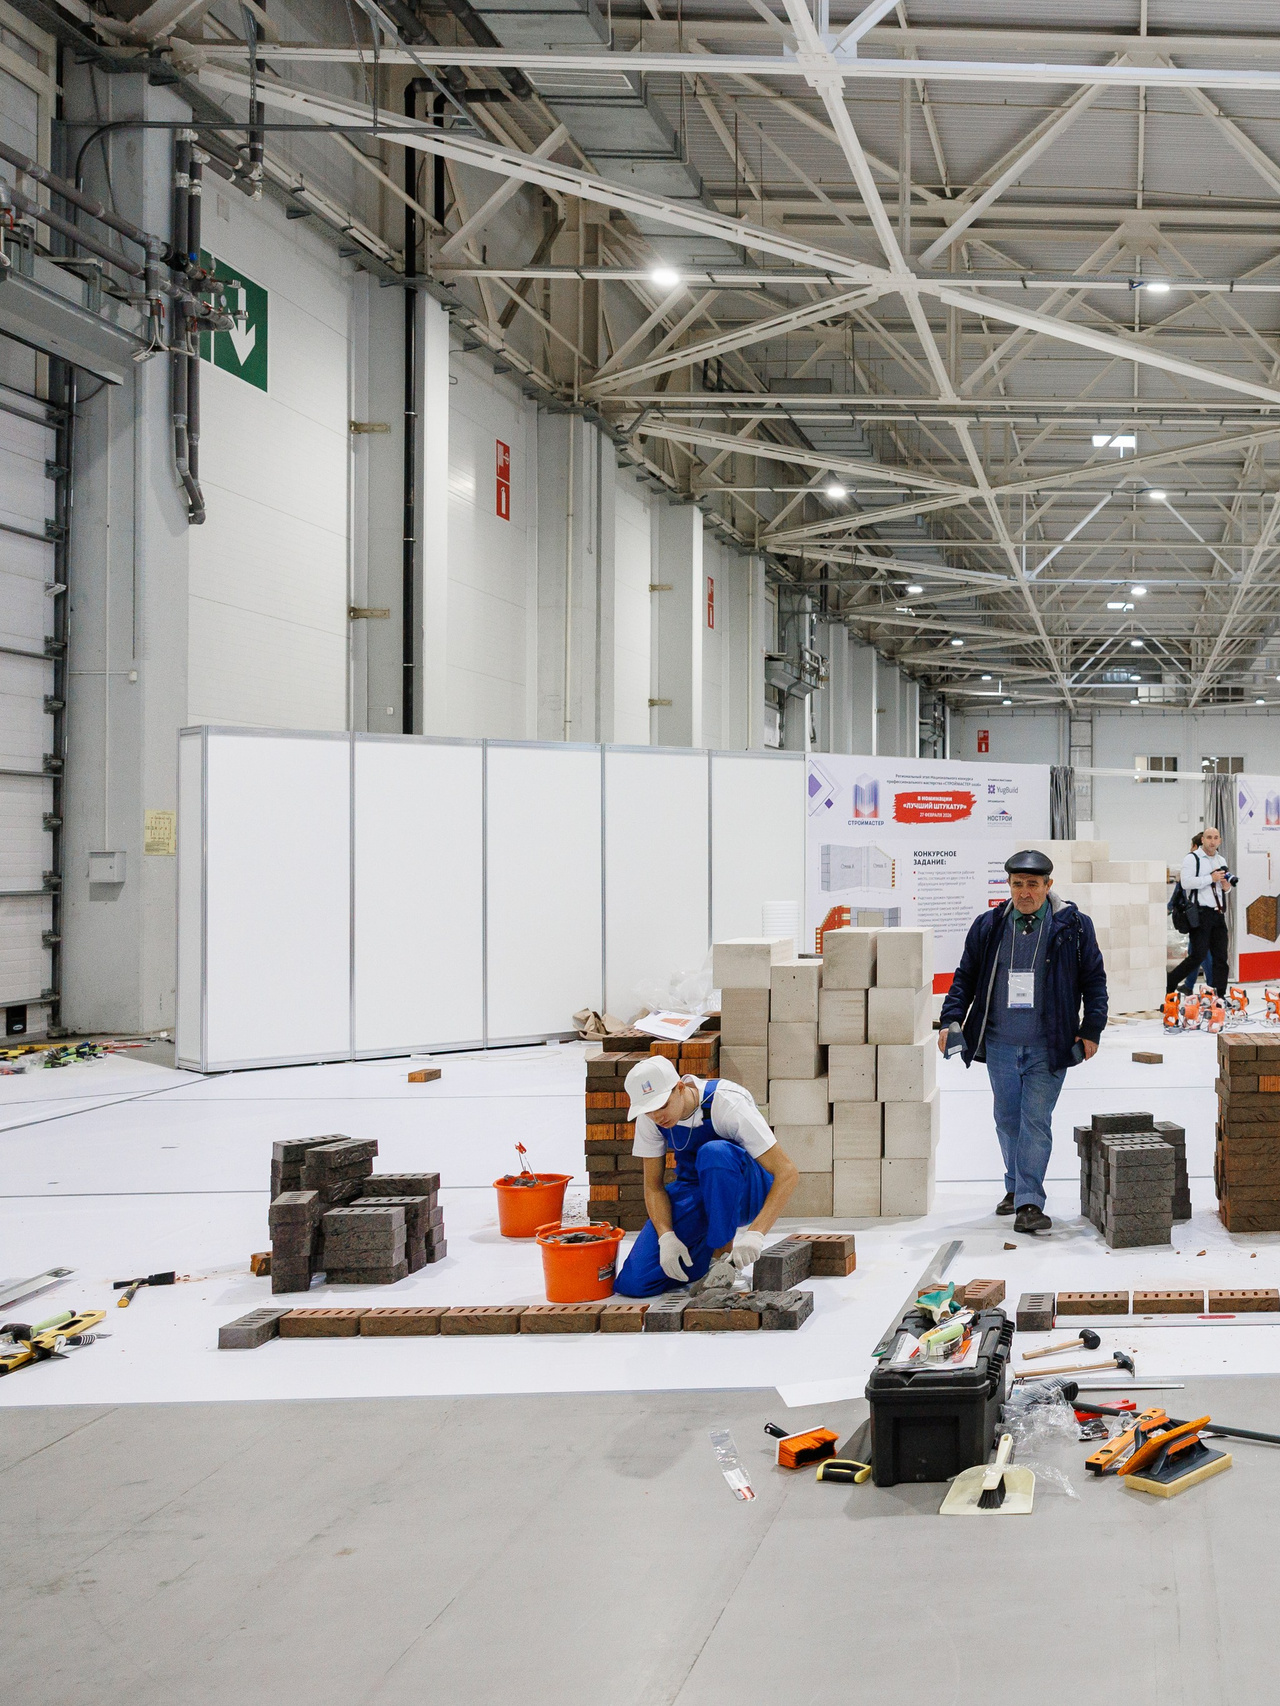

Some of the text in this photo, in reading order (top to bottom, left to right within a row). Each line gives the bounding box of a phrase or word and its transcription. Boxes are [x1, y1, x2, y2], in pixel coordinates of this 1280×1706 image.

[996, 785, 1019, 795] YugBuild
[903, 801, 967, 810] «ЛУЧШИЙ ШТУКАТУР»
[913, 858, 947, 866] ЗАДАНИЕ:
